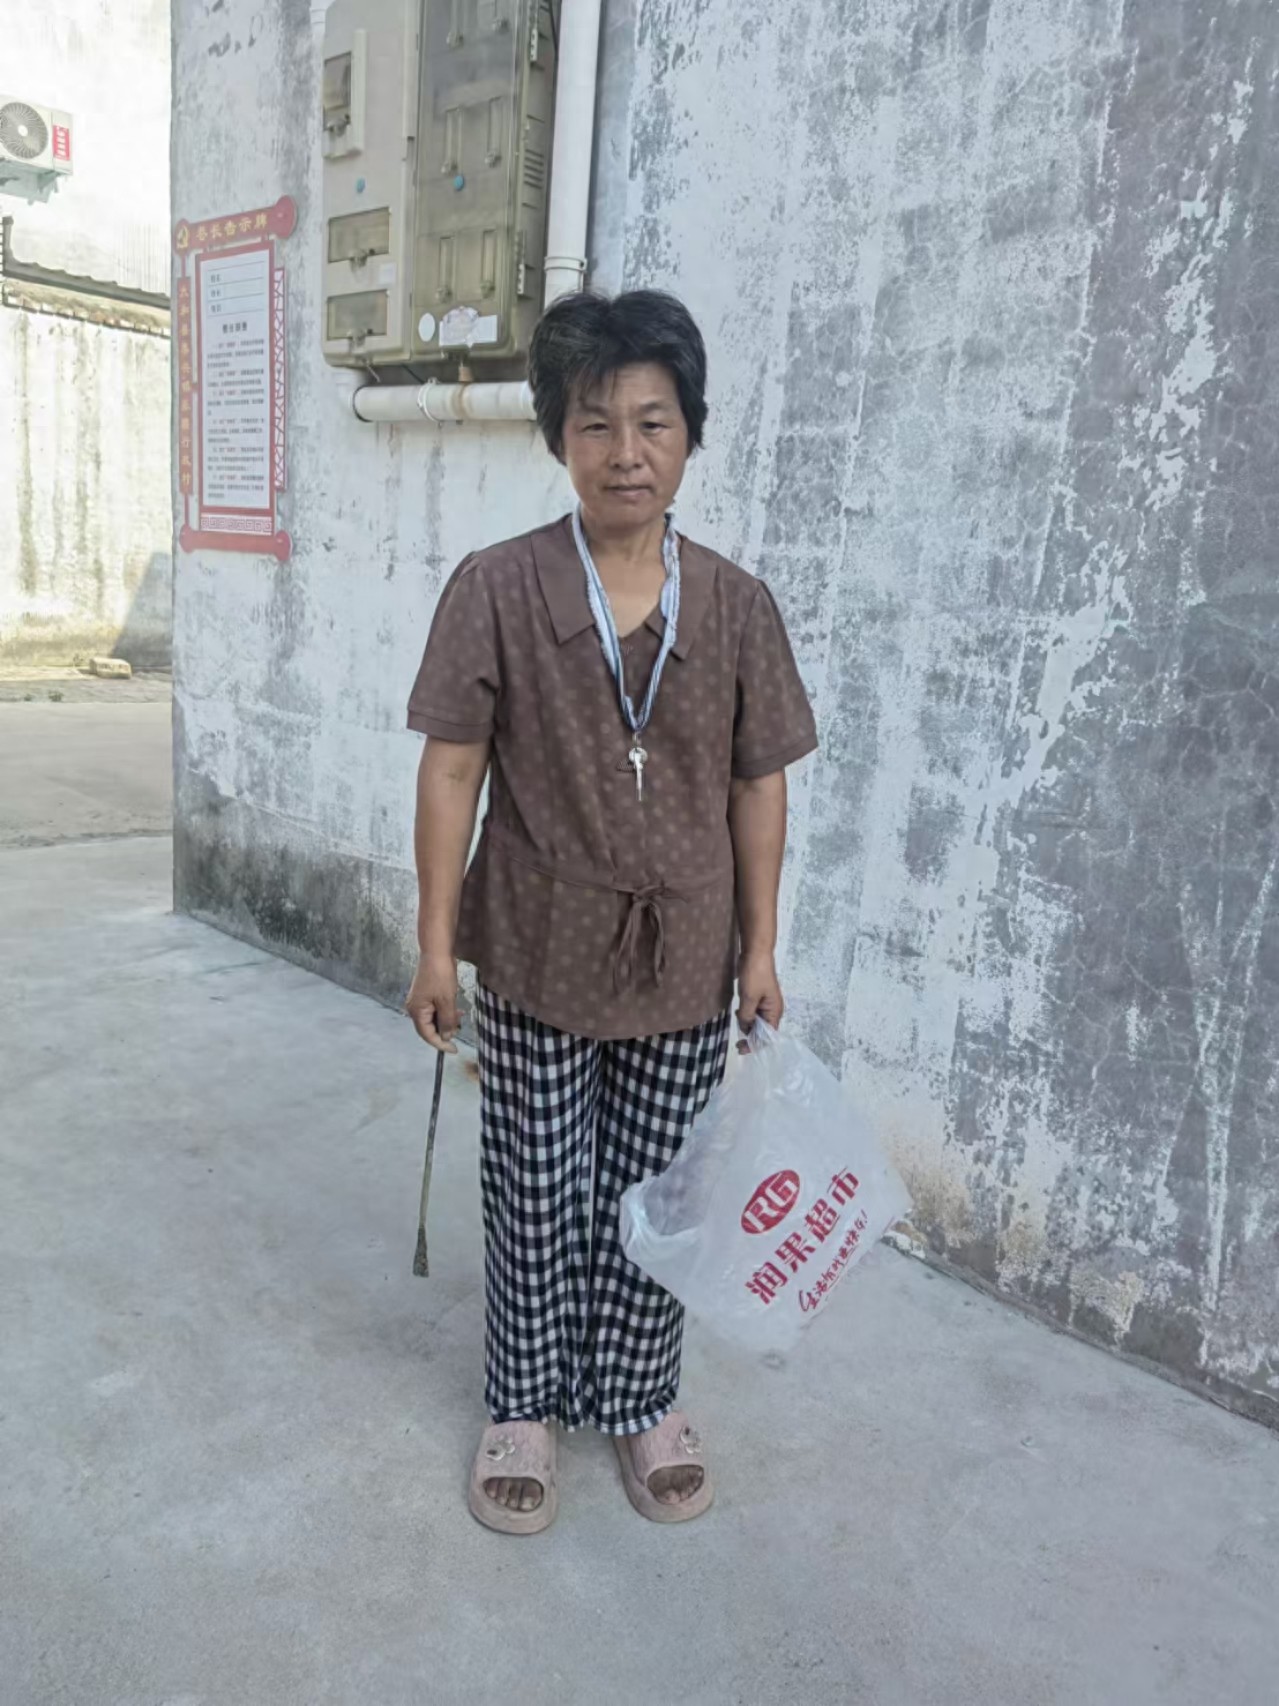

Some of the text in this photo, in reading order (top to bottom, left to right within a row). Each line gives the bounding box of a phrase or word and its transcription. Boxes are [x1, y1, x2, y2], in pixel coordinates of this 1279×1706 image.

[744, 1171, 799, 1232] RG
[744, 1166, 859, 1305] 润果超市
